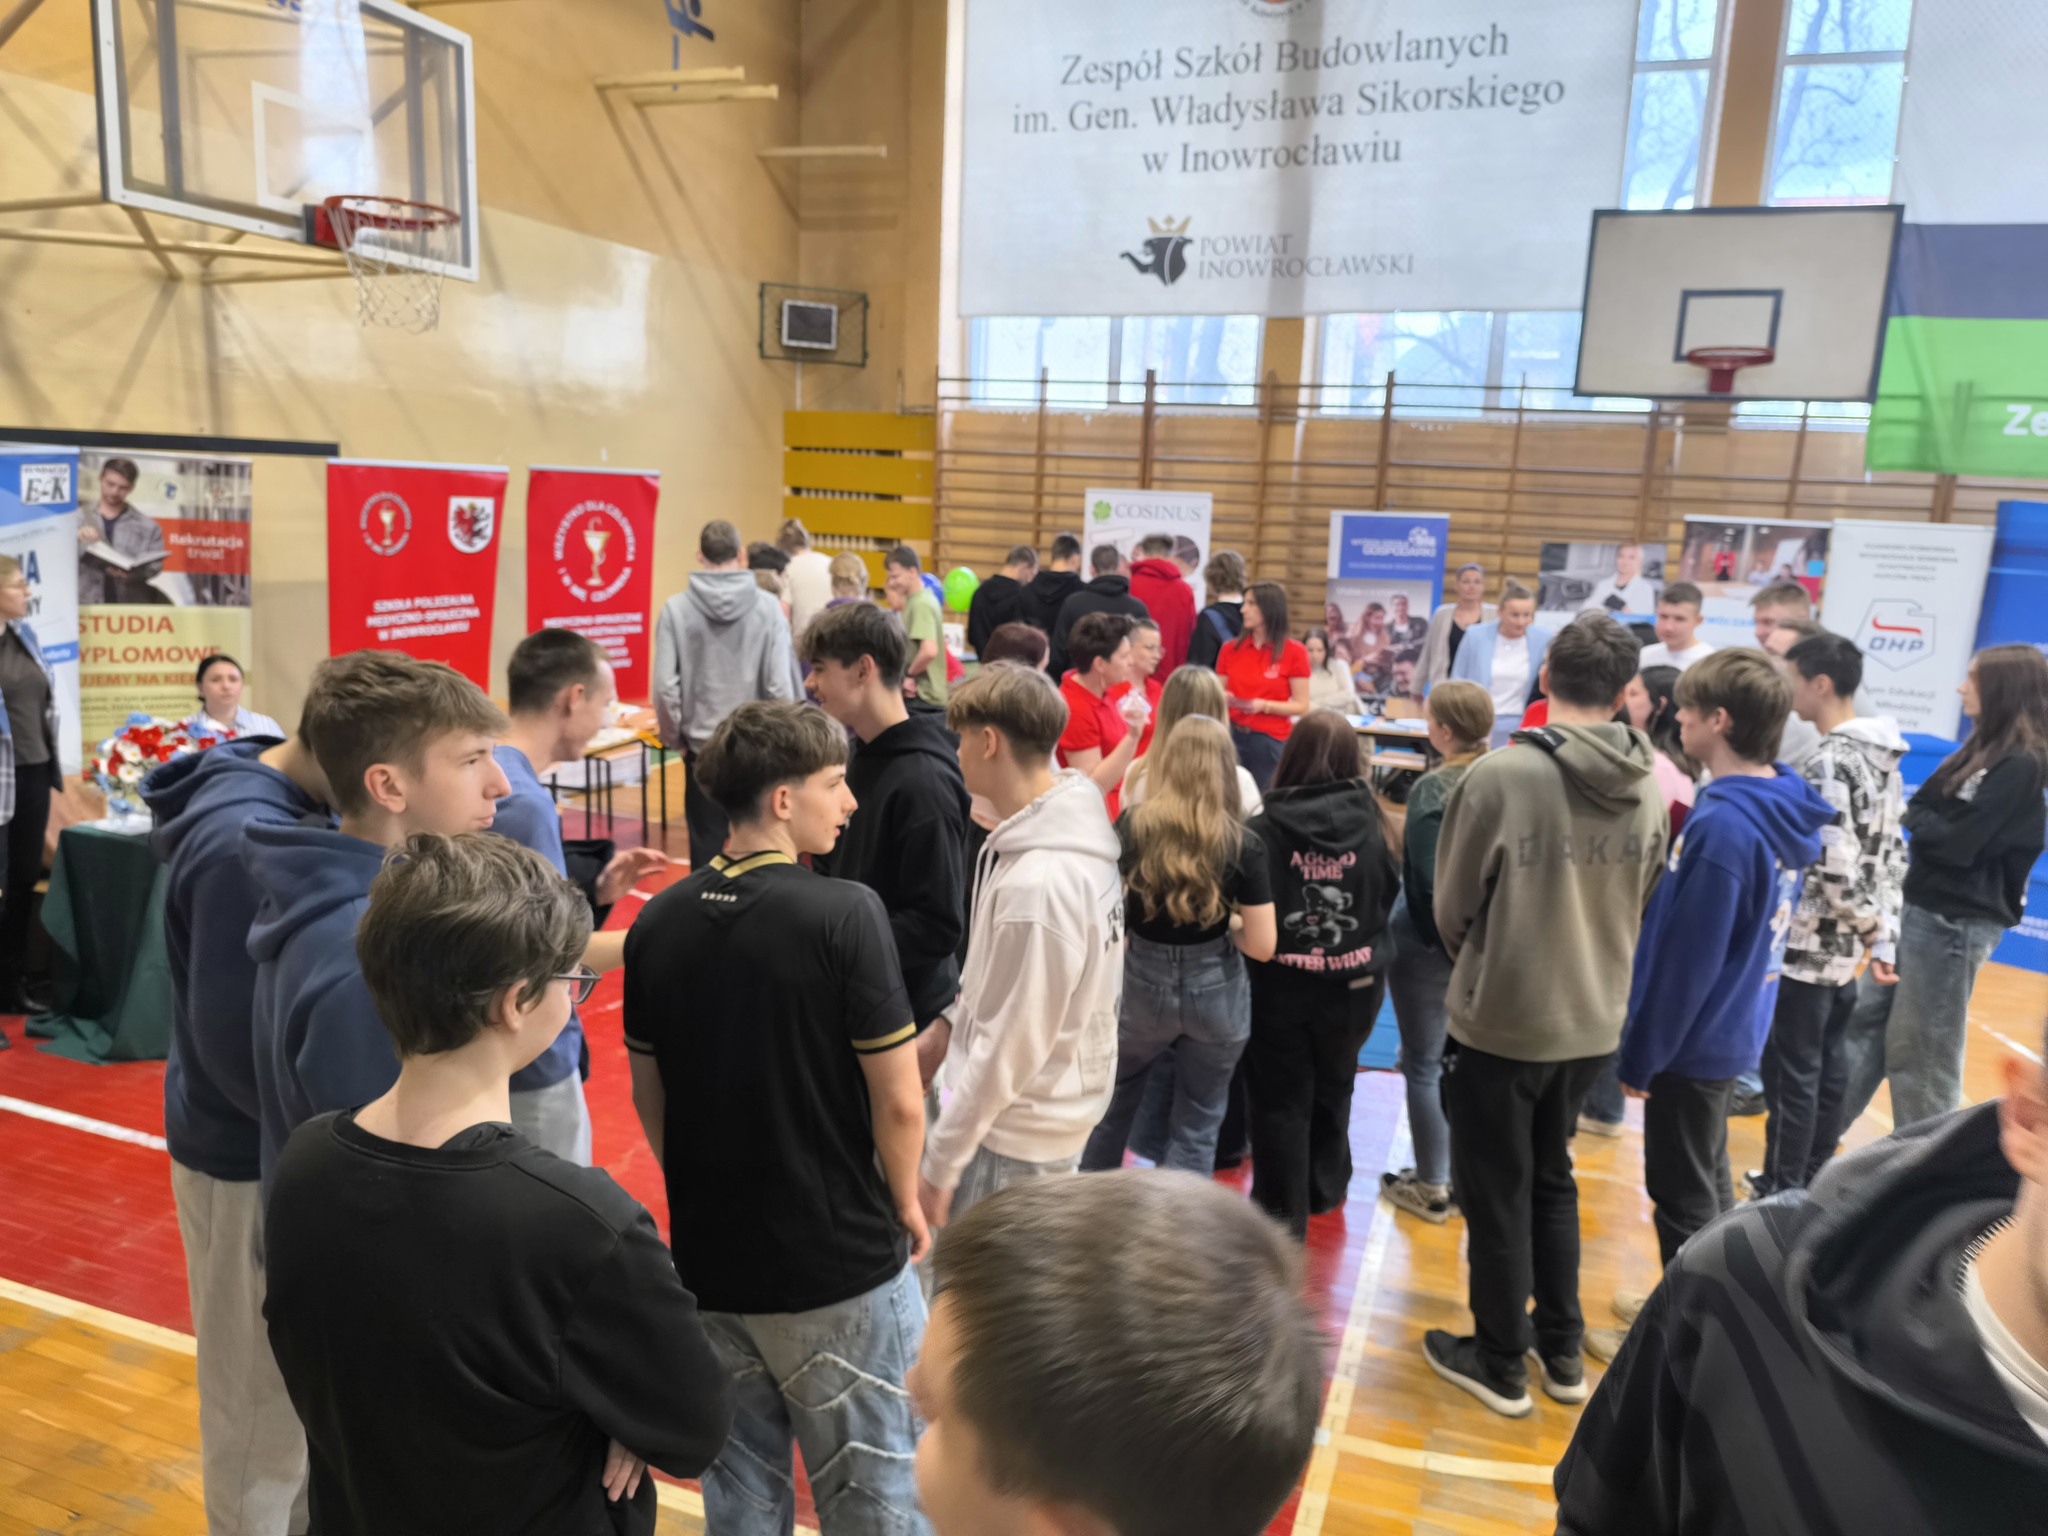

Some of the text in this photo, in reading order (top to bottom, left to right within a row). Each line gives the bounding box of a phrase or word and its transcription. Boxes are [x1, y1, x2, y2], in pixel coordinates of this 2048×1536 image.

[1062, 24, 1510, 91] Zespół Szkół Budowlanych
[1013, 74, 1565, 133] im. Gen. Władysława Sikorskiego
[1142, 132, 1402, 174] w Inowrocławiu
[1200, 234, 1293, 257] POWIAT
[1199, 253, 1414, 279] INOWROCŁAWSKI
[1115, 502, 1201, 521] COSINUS
[169, 533, 244, 550] Rekrutacja
[79, 615, 174, 634] STUDIA
[1868, 637, 1925, 651] OHP
[1301, 864, 1344, 881] TIME
[1272, 945, 1373, 971] ATTER WHAT
